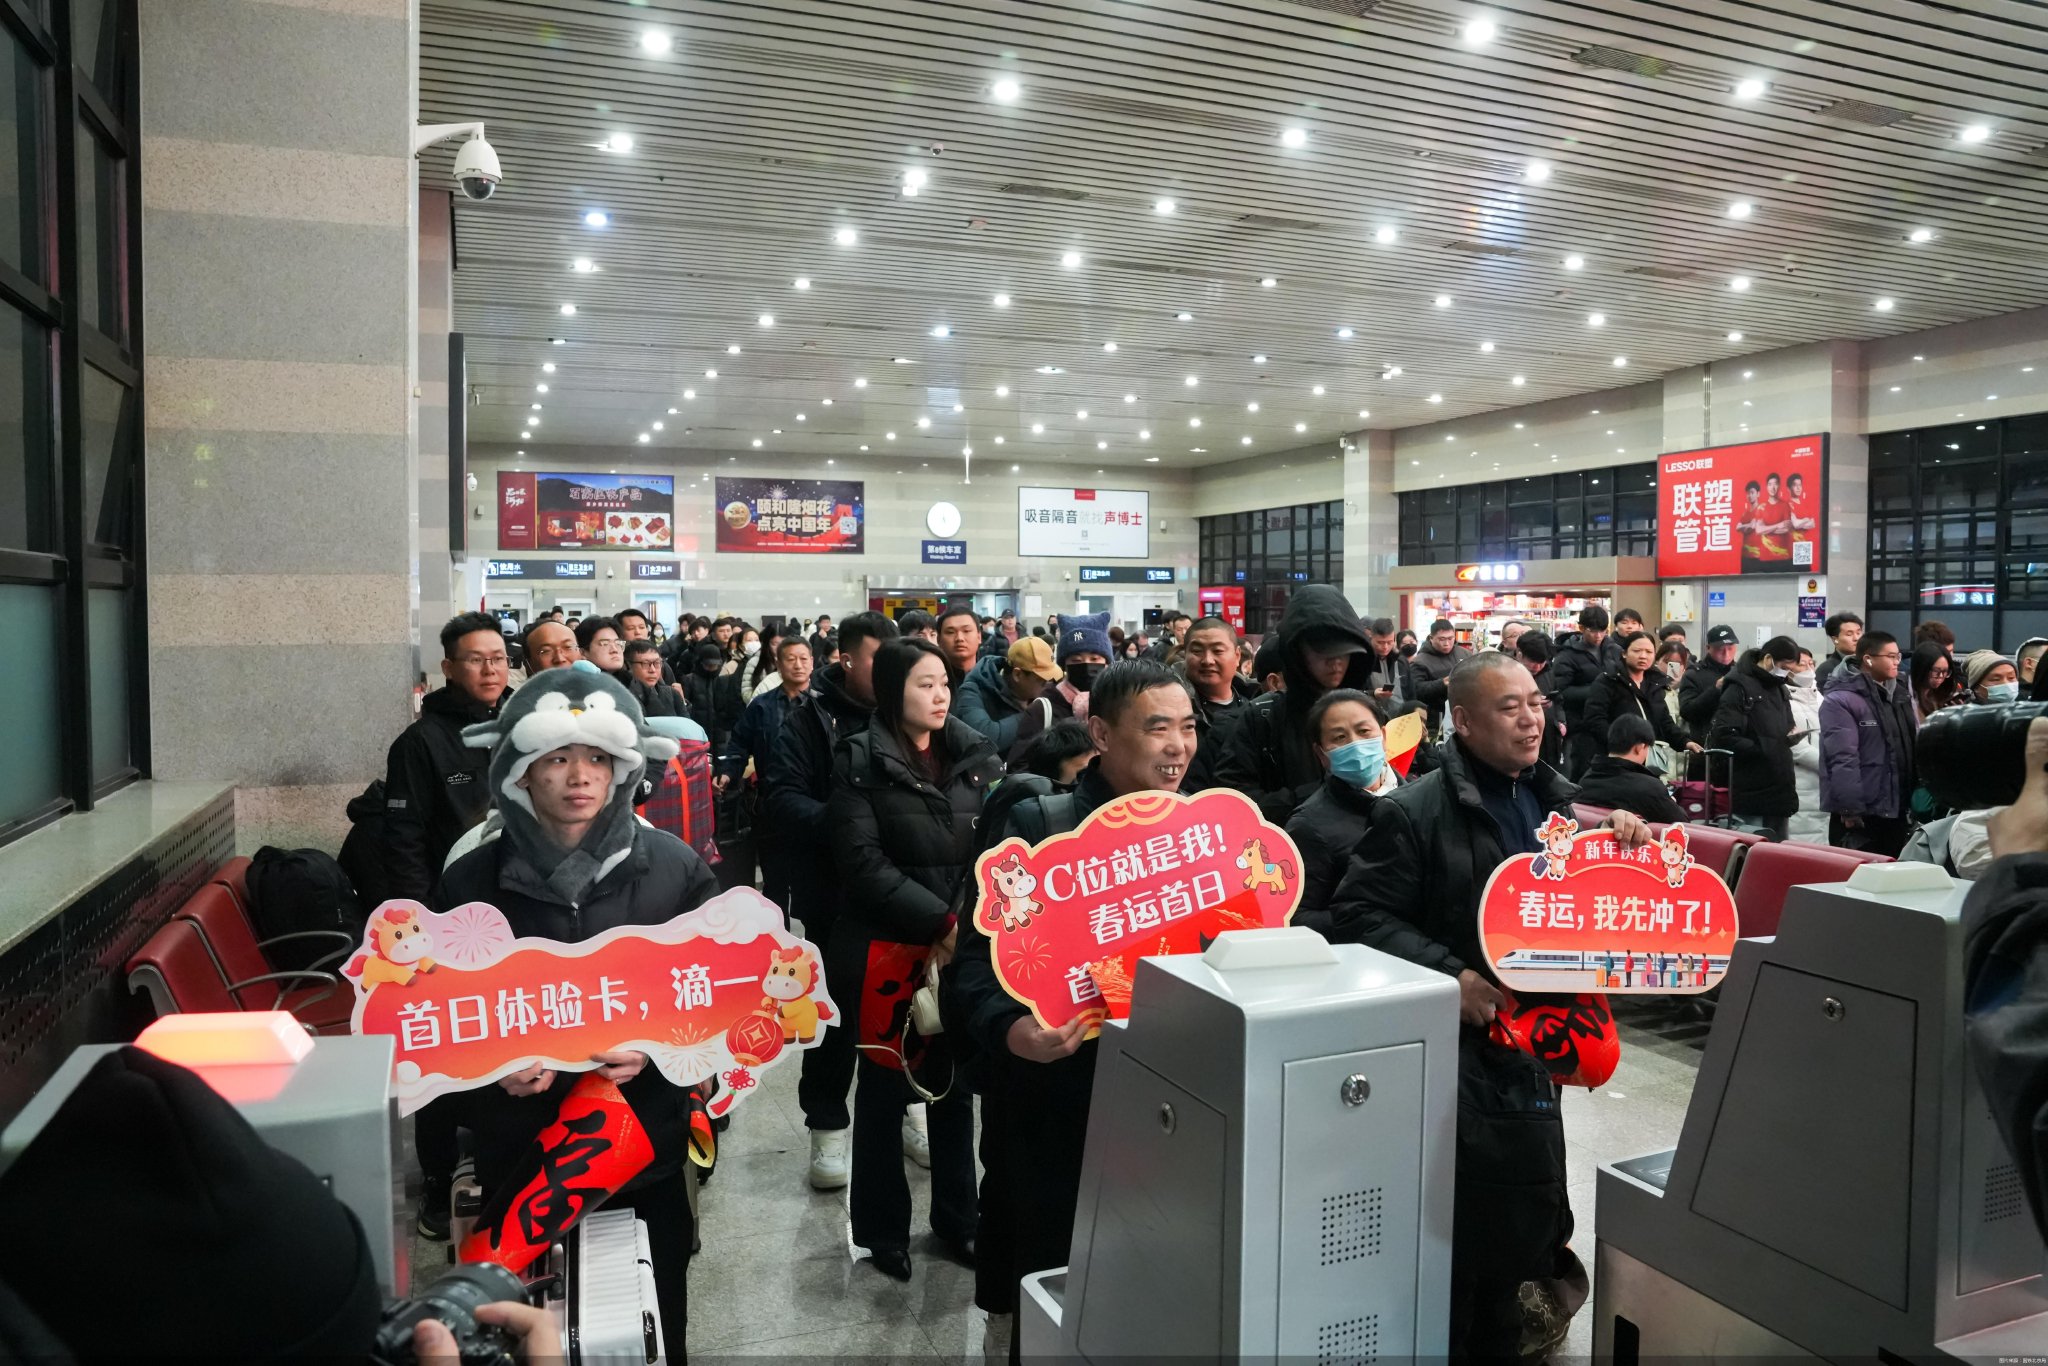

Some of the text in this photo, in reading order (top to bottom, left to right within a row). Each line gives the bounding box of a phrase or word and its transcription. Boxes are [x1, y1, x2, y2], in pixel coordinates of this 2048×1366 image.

[756, 498, 832, 515] 颐和隆烟花
[1673, 478, 1733, 517] 联塑
[756, 516, 832, 533] 点亮中国年
[1024, 508, 1143, 526] 吸音隔音就找声博士
[1673, 515, 1733, 553] 管道
[1043, 822, 1227, 902] C位就是我！
[1088, 870, 1226, 945] 春运首日
[1518, 891, 1711, 935] 春运，我先冲了！
